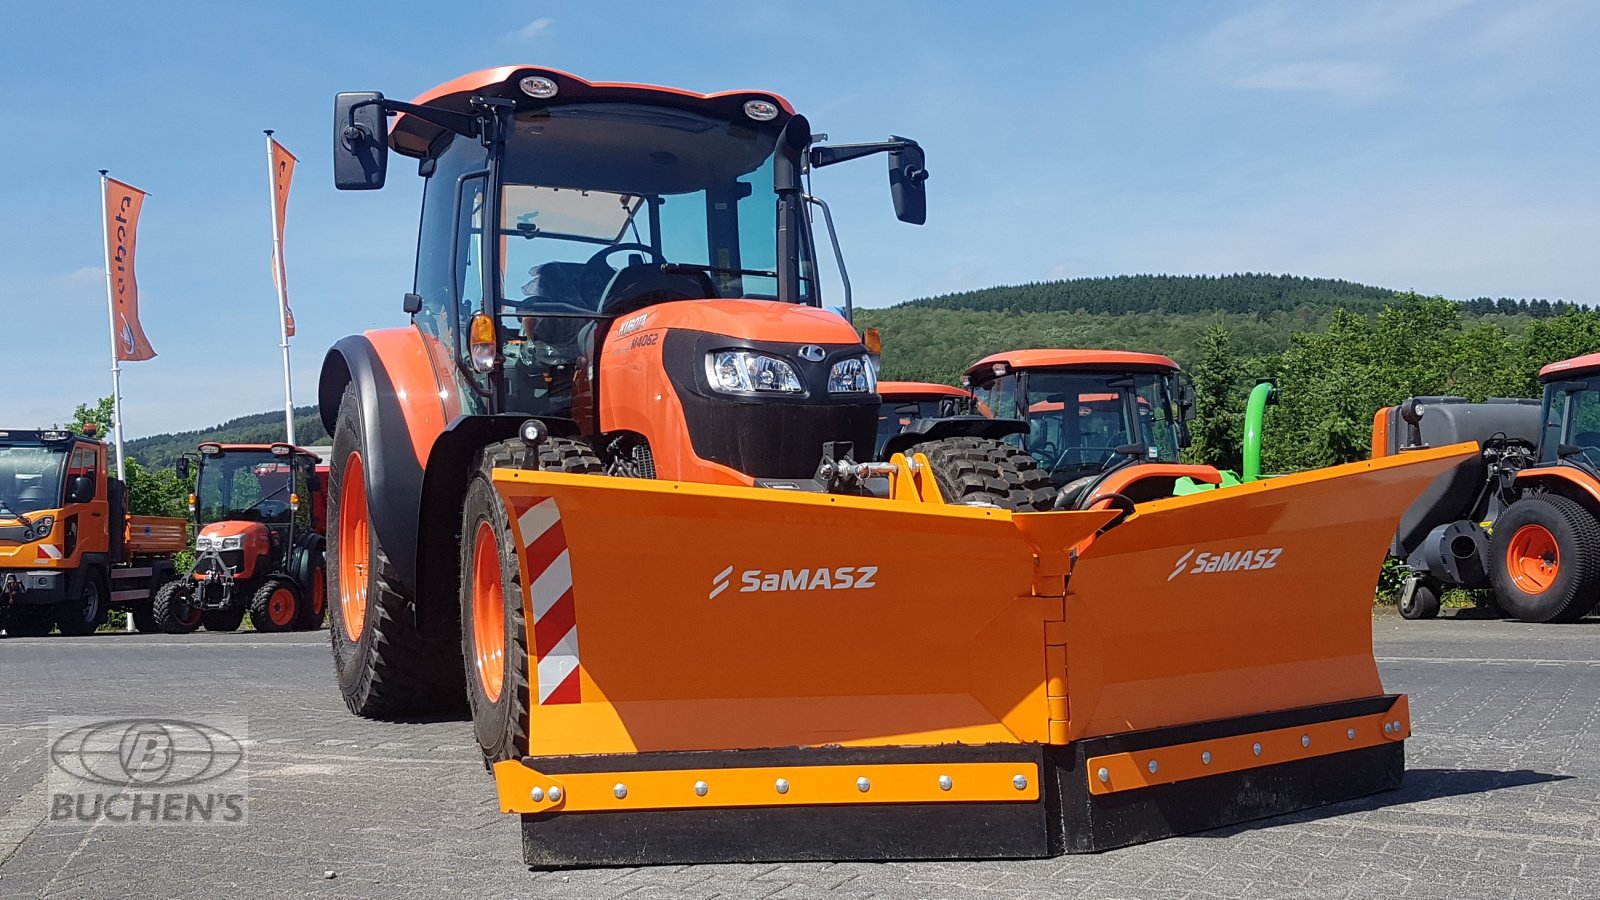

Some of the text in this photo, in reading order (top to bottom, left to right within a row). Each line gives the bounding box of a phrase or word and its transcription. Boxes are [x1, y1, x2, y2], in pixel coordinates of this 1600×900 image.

[630, 333, 659, 351] M4062
[1189, 547, 1284, 574] SaMASZ
[739, 566, 879, 593] SaMASZ
